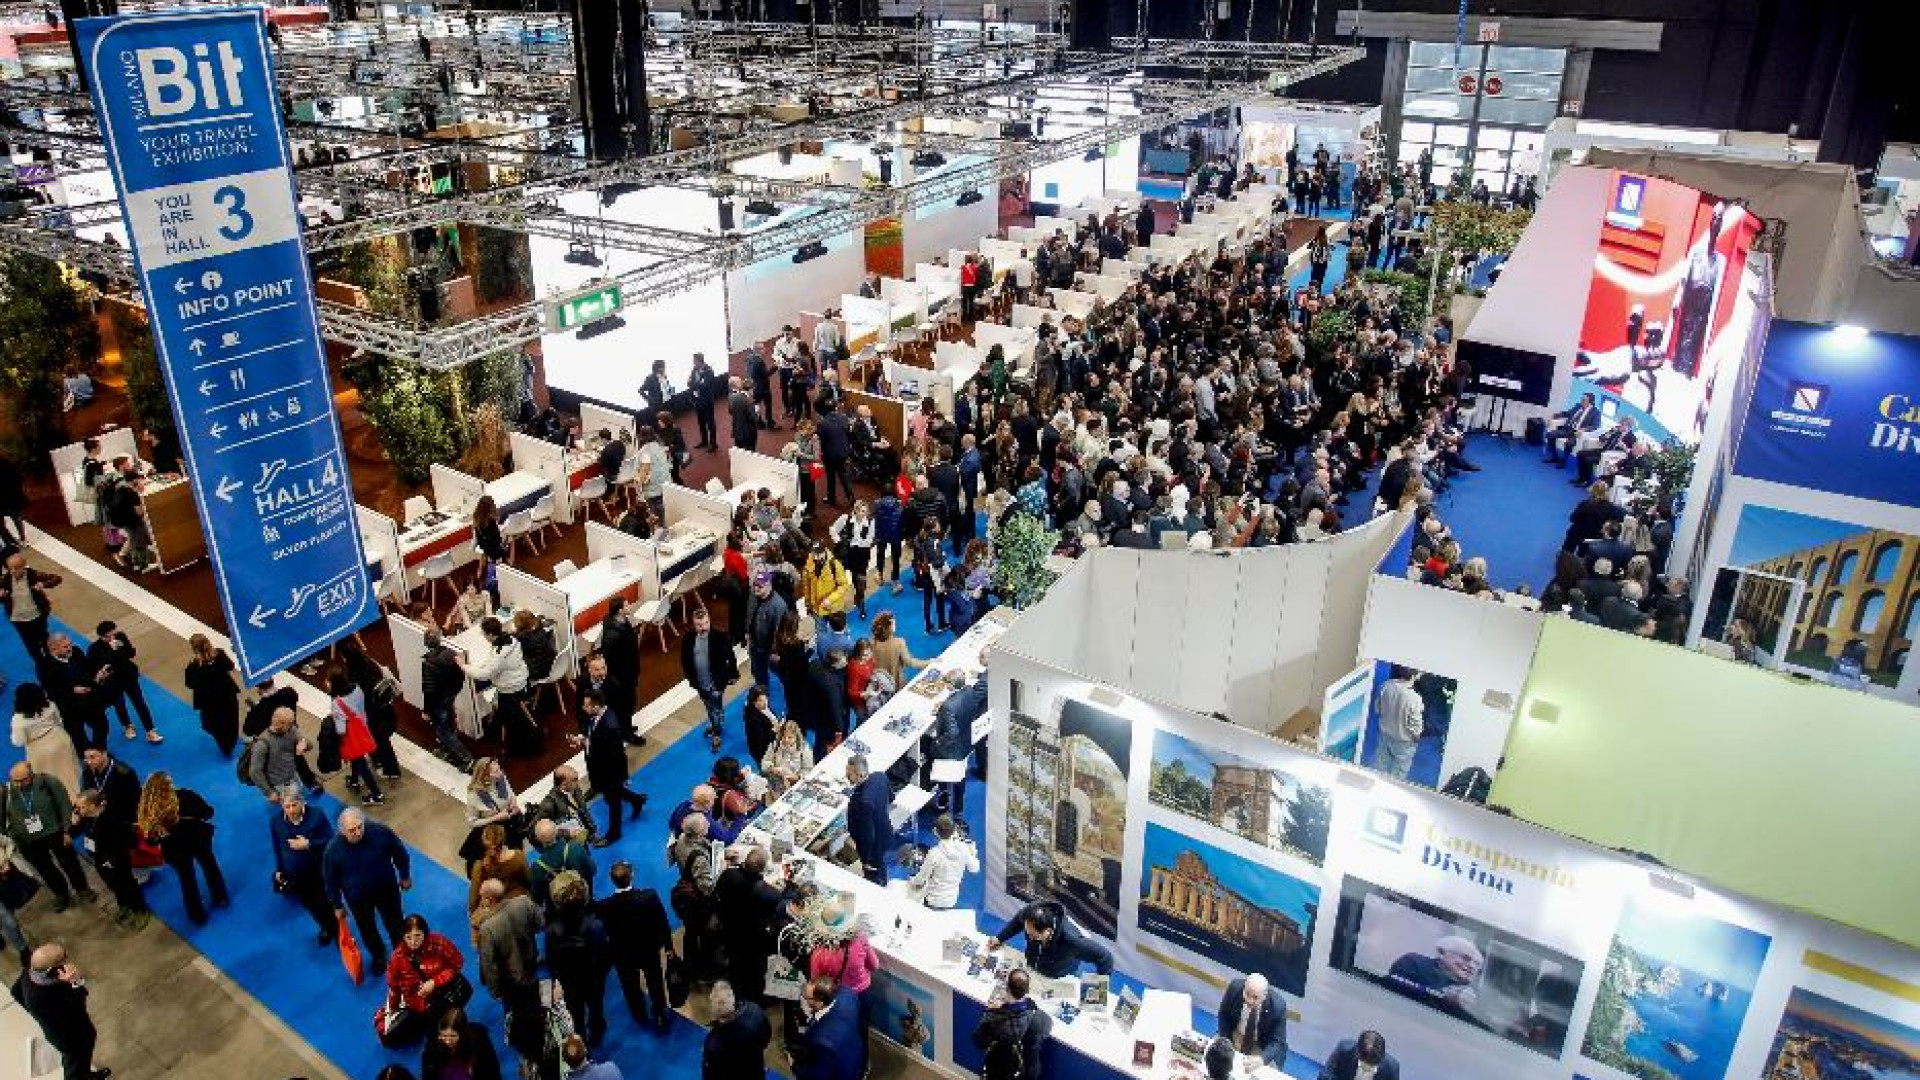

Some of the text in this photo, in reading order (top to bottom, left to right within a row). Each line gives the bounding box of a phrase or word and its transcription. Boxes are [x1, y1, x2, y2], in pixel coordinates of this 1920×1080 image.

[120, 50, 147, 120] MILANO
[136, 40, 244, 116] Bit
[140, 125, 258, 152] YOUR TRAVEL
[152, 140, 255, 168] EXHIBITION.
[154, 192, 192, 211] YOU
[159, 209, 195, 227] ARE
[213, 184, 254, 241] 3
[162, 226, 179, 241] IN
[165, 235, 212, 255] HALL
[178, 279, 294, 320] INFO POINT
[255, 478, 324, 515] HALL
[321, 458, 339, 487] 4
[317, 575, 357, 612] EXIT
[1421, 844, 1515, 895] Divina
